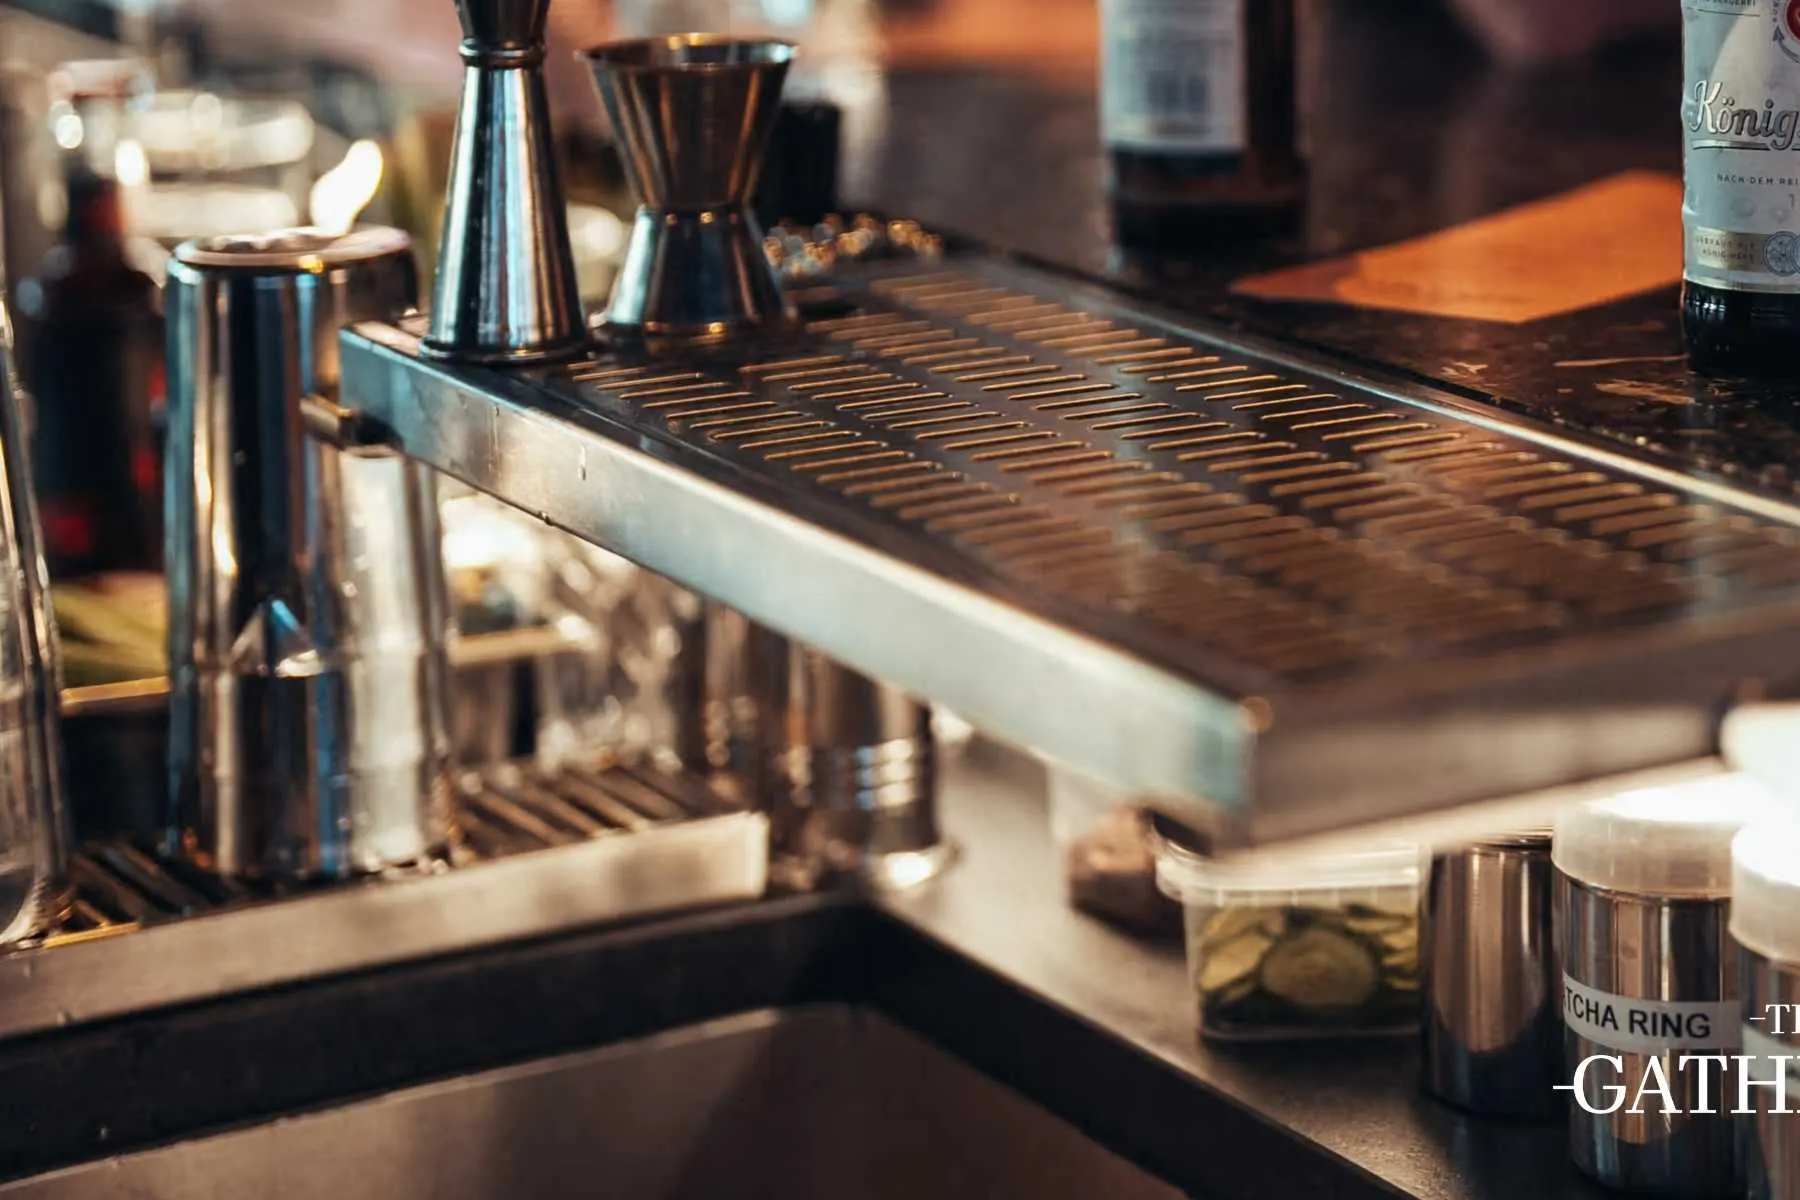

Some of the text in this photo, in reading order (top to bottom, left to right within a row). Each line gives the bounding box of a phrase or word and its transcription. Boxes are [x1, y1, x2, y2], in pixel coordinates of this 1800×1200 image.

[1687, 79, 1799, 150] König
[1717, 173, 1745, 184] NACH
[1750, 176, 1774, 185] DEM
[1564, 986, 1711, 1039] TCHA RING
